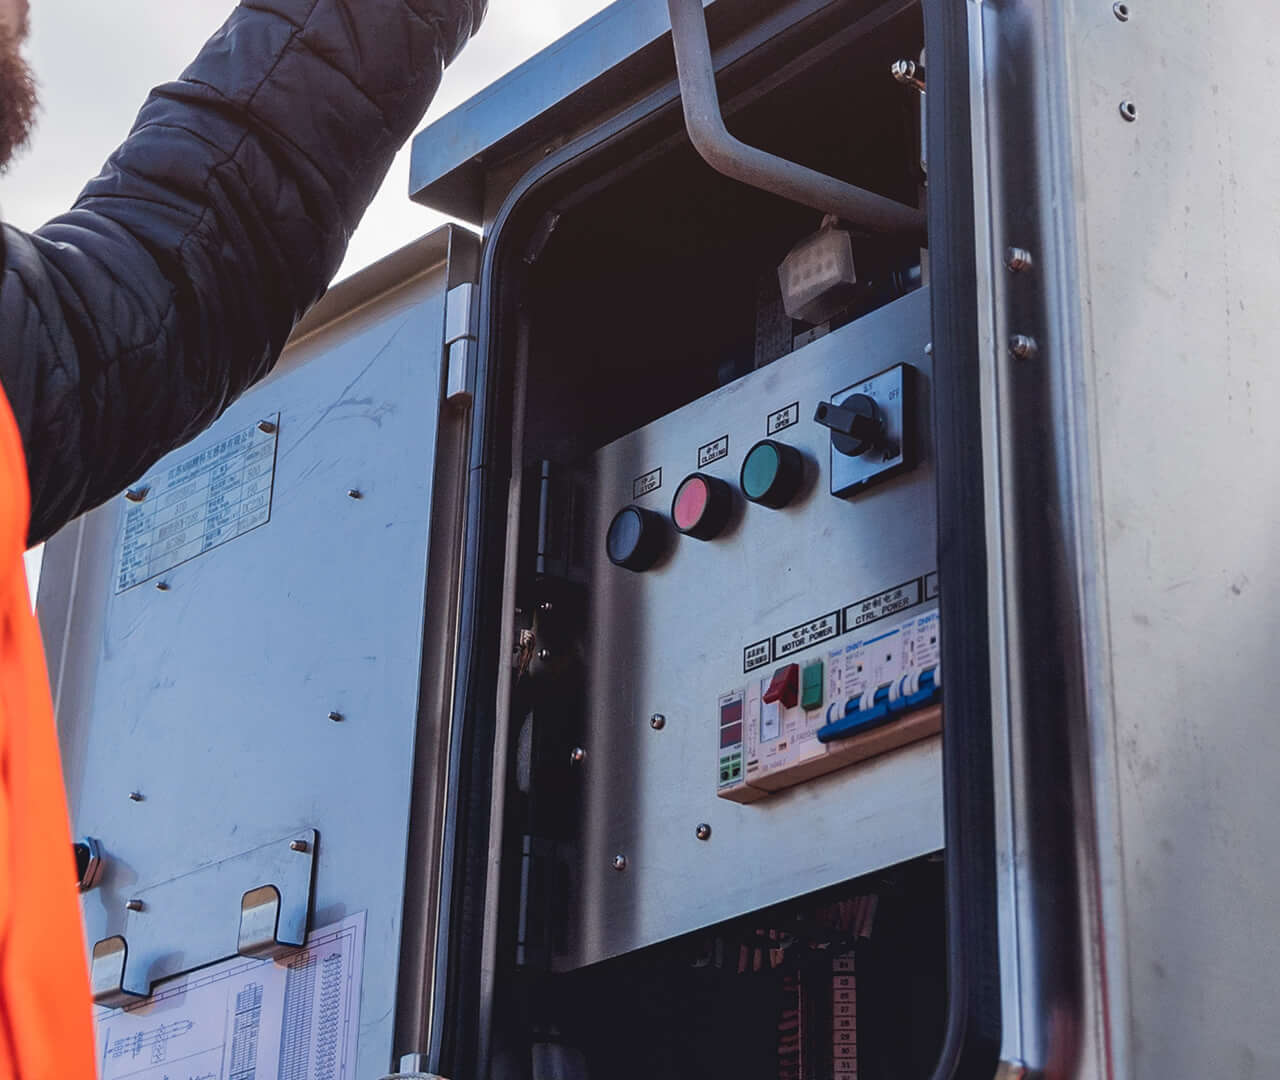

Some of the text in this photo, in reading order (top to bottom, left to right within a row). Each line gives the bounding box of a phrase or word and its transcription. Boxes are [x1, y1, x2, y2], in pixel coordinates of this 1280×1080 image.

[774, 418, 790, 429] OPEN
[701, 447, 727, 464] CLOSING
[639, 481, 656, 493] STOP
[855, 597, 910, 625] CTRL POWER
[782, 637, 806, 653] MOTOR
[808, 626, 833, 642] POWER
